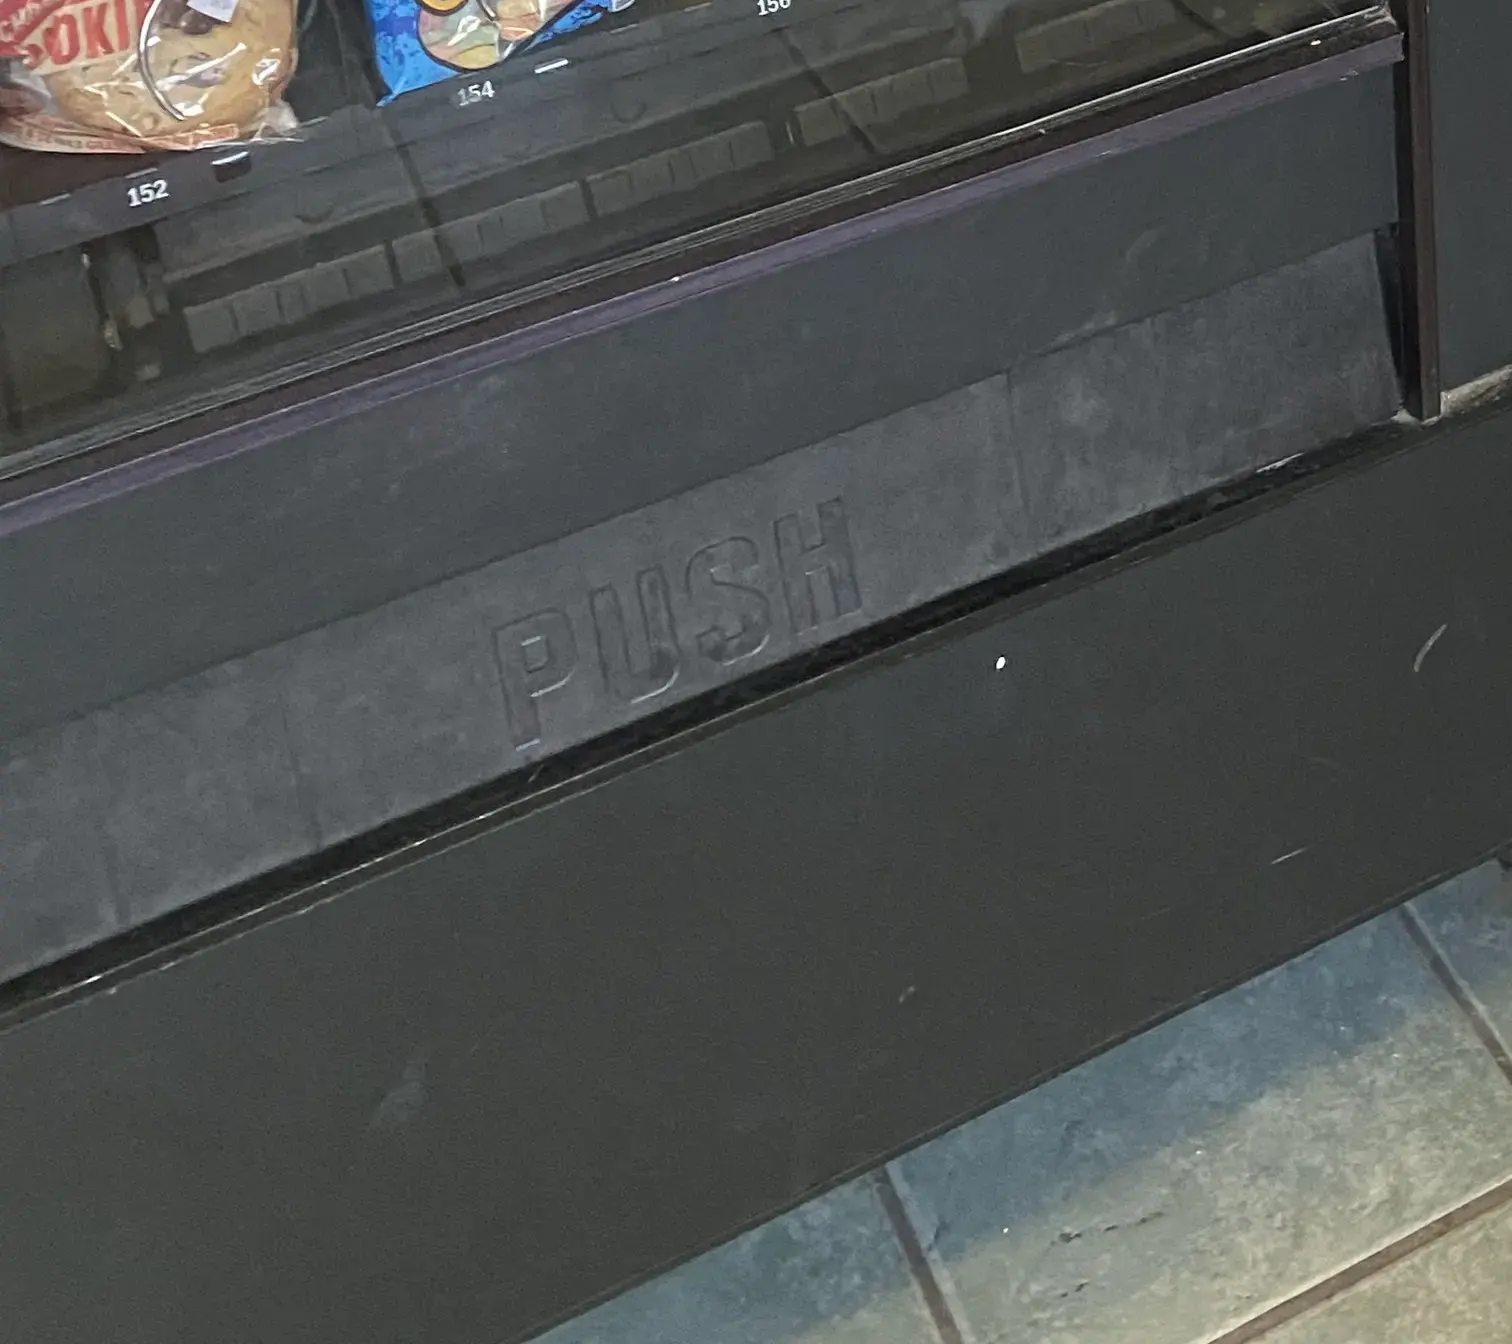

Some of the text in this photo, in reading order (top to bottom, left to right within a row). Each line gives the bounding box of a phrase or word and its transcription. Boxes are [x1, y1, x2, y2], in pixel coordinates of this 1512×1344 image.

[457, 81, 496, 107] 154
[126, 179, 170, 207] 152
[490, 495, 863, 751] PUSH
